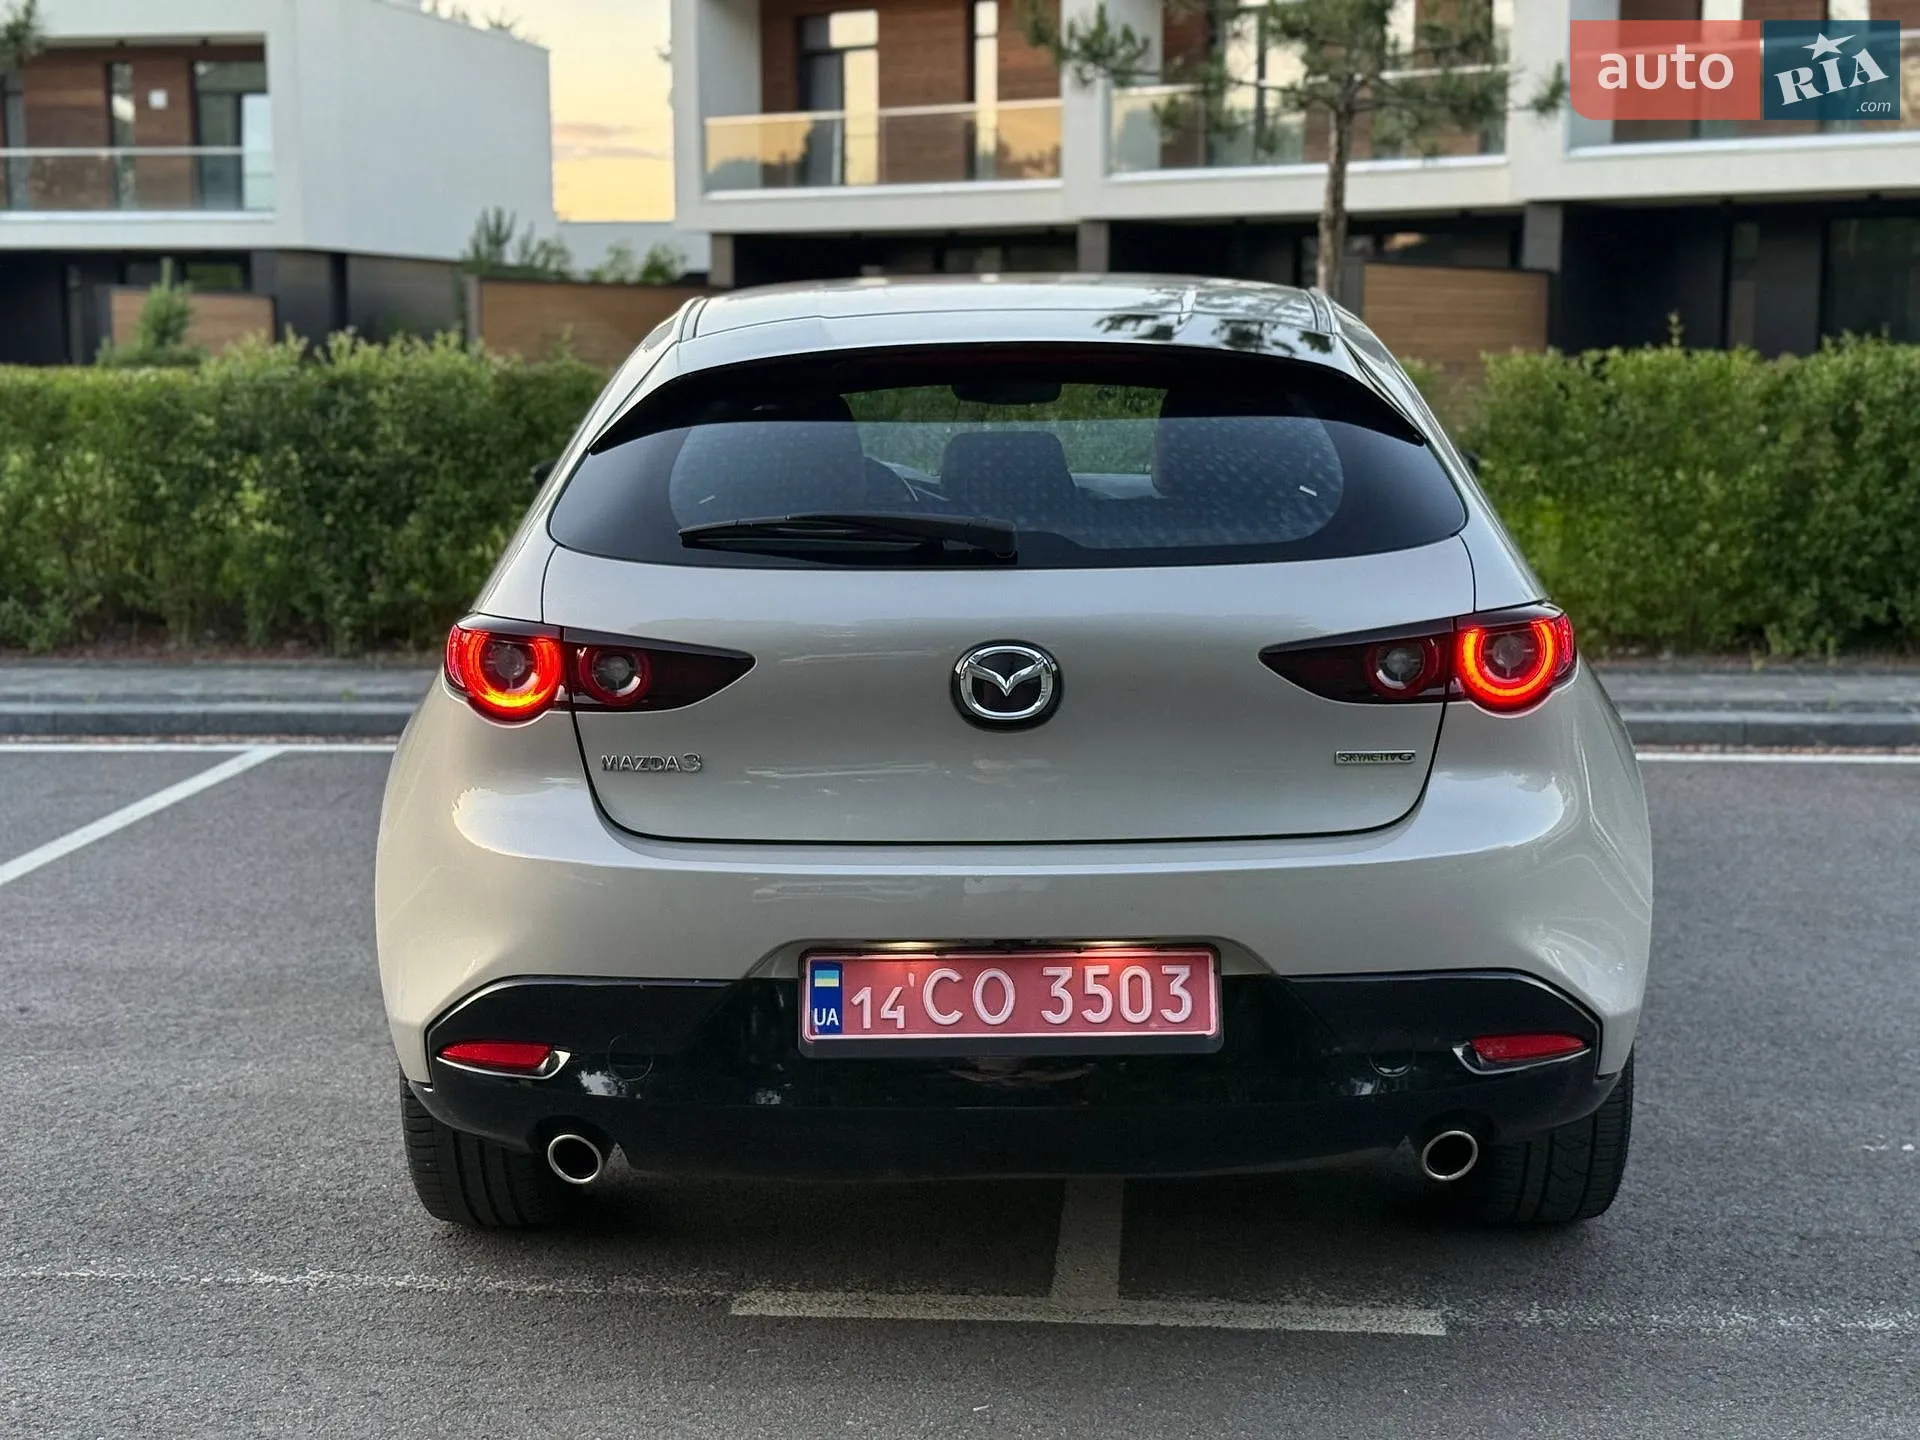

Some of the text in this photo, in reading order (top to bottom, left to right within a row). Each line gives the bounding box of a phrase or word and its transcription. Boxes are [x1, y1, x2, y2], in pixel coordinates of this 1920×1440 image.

[813, 1007, 839, 1026] UA
[851, 965, 1192, 1029] 14 CO 3503
